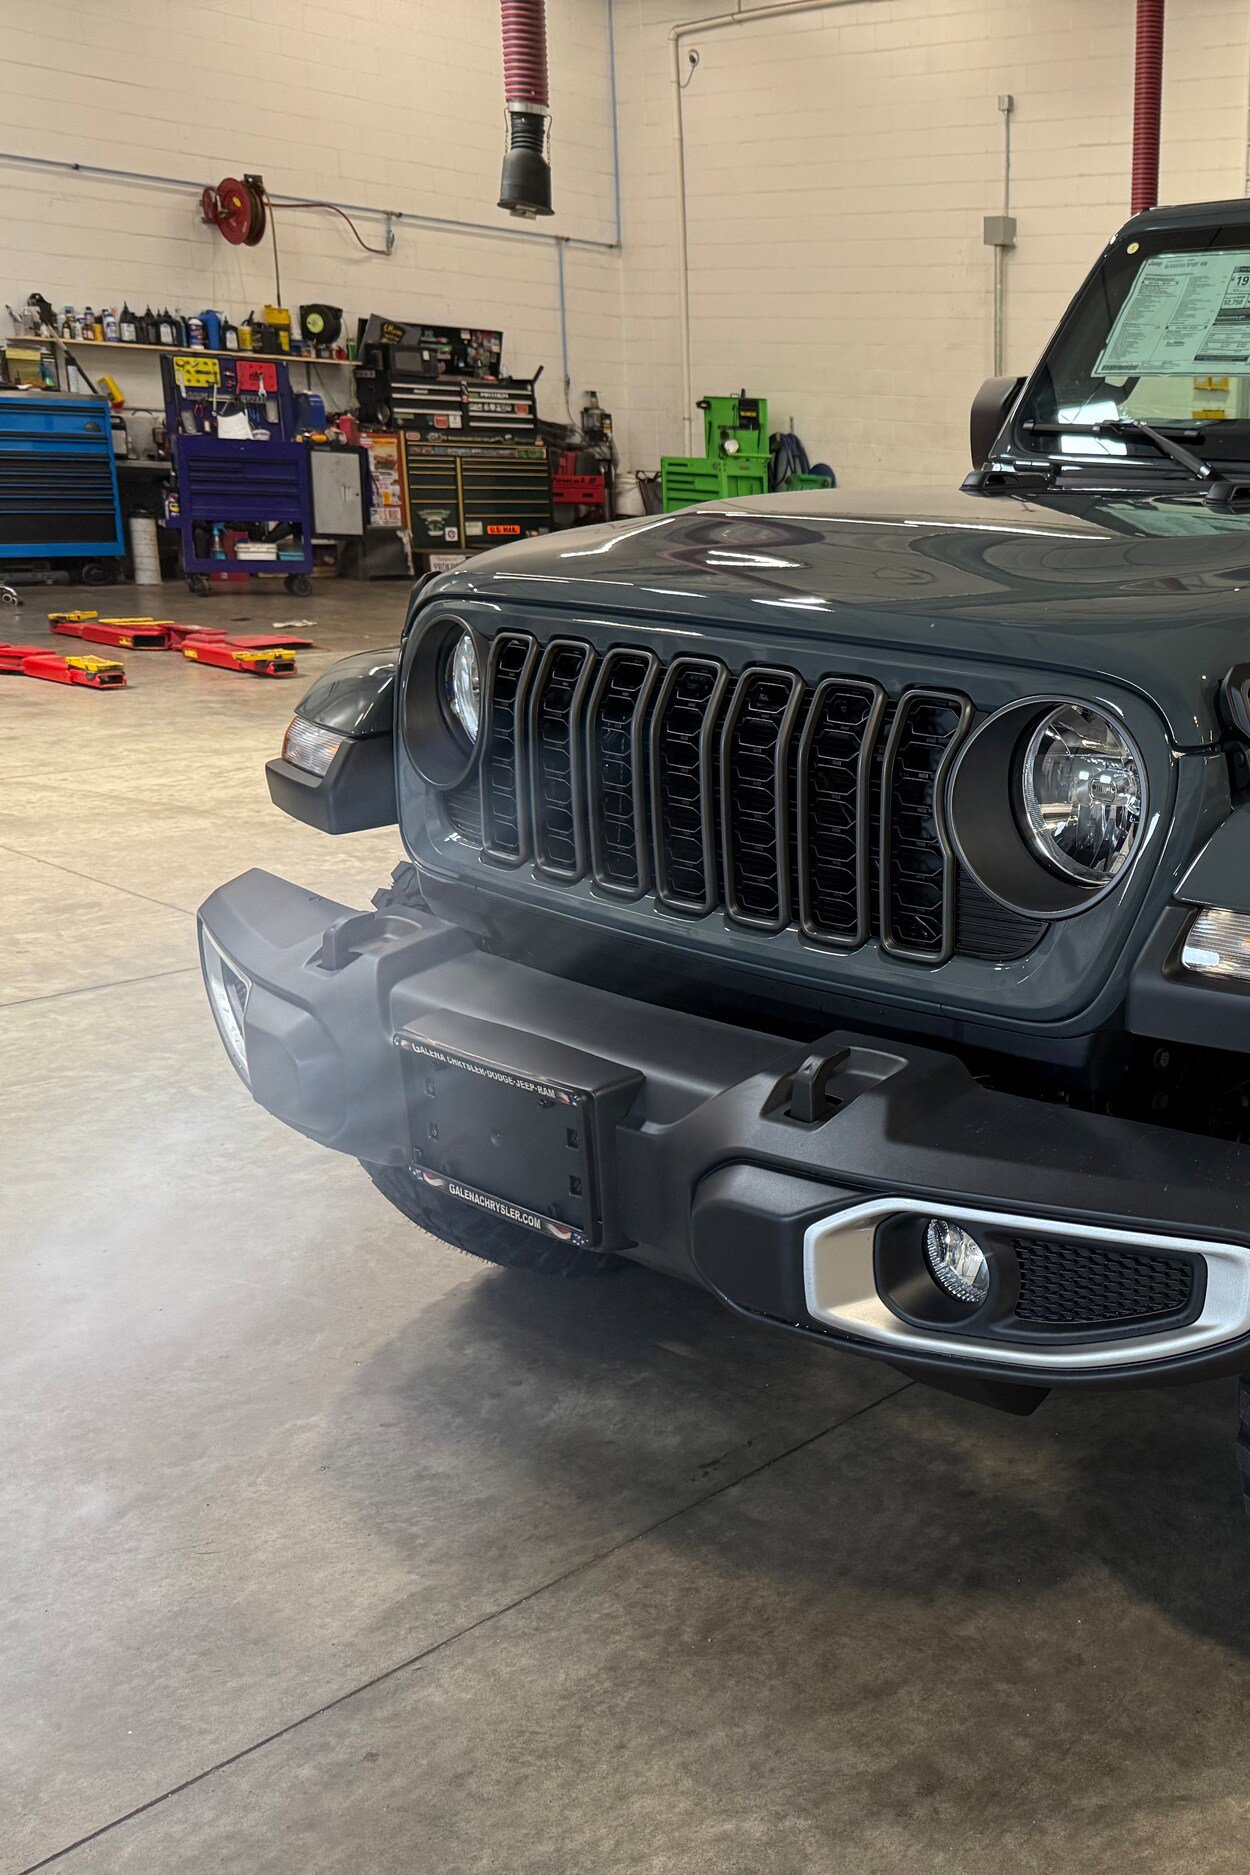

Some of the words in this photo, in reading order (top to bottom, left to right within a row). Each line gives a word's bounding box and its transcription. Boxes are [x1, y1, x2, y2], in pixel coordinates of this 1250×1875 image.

[1236, 276, 1250, 286] 19
[412, 1043, 447, 1063] GALENA
[449, 1183, 541, 1229] GALENACHRYSLER.COM
